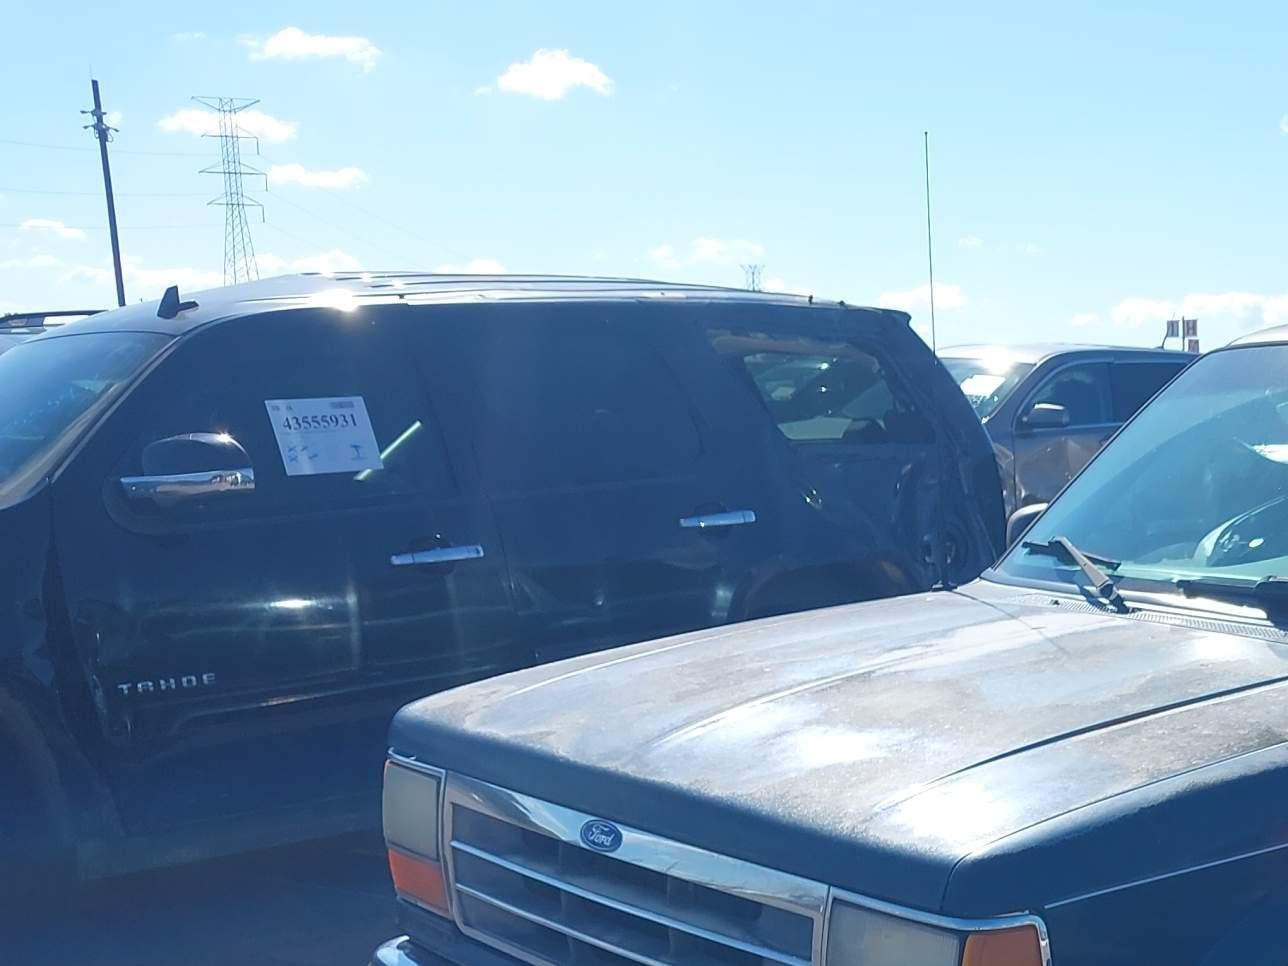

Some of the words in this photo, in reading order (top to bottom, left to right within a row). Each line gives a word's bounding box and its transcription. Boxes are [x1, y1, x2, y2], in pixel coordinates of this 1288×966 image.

[282, 413, 357, 431] 43555931
[117, 672, 216, 695] TAHOE
[587, 823, 616, 847] Ford
